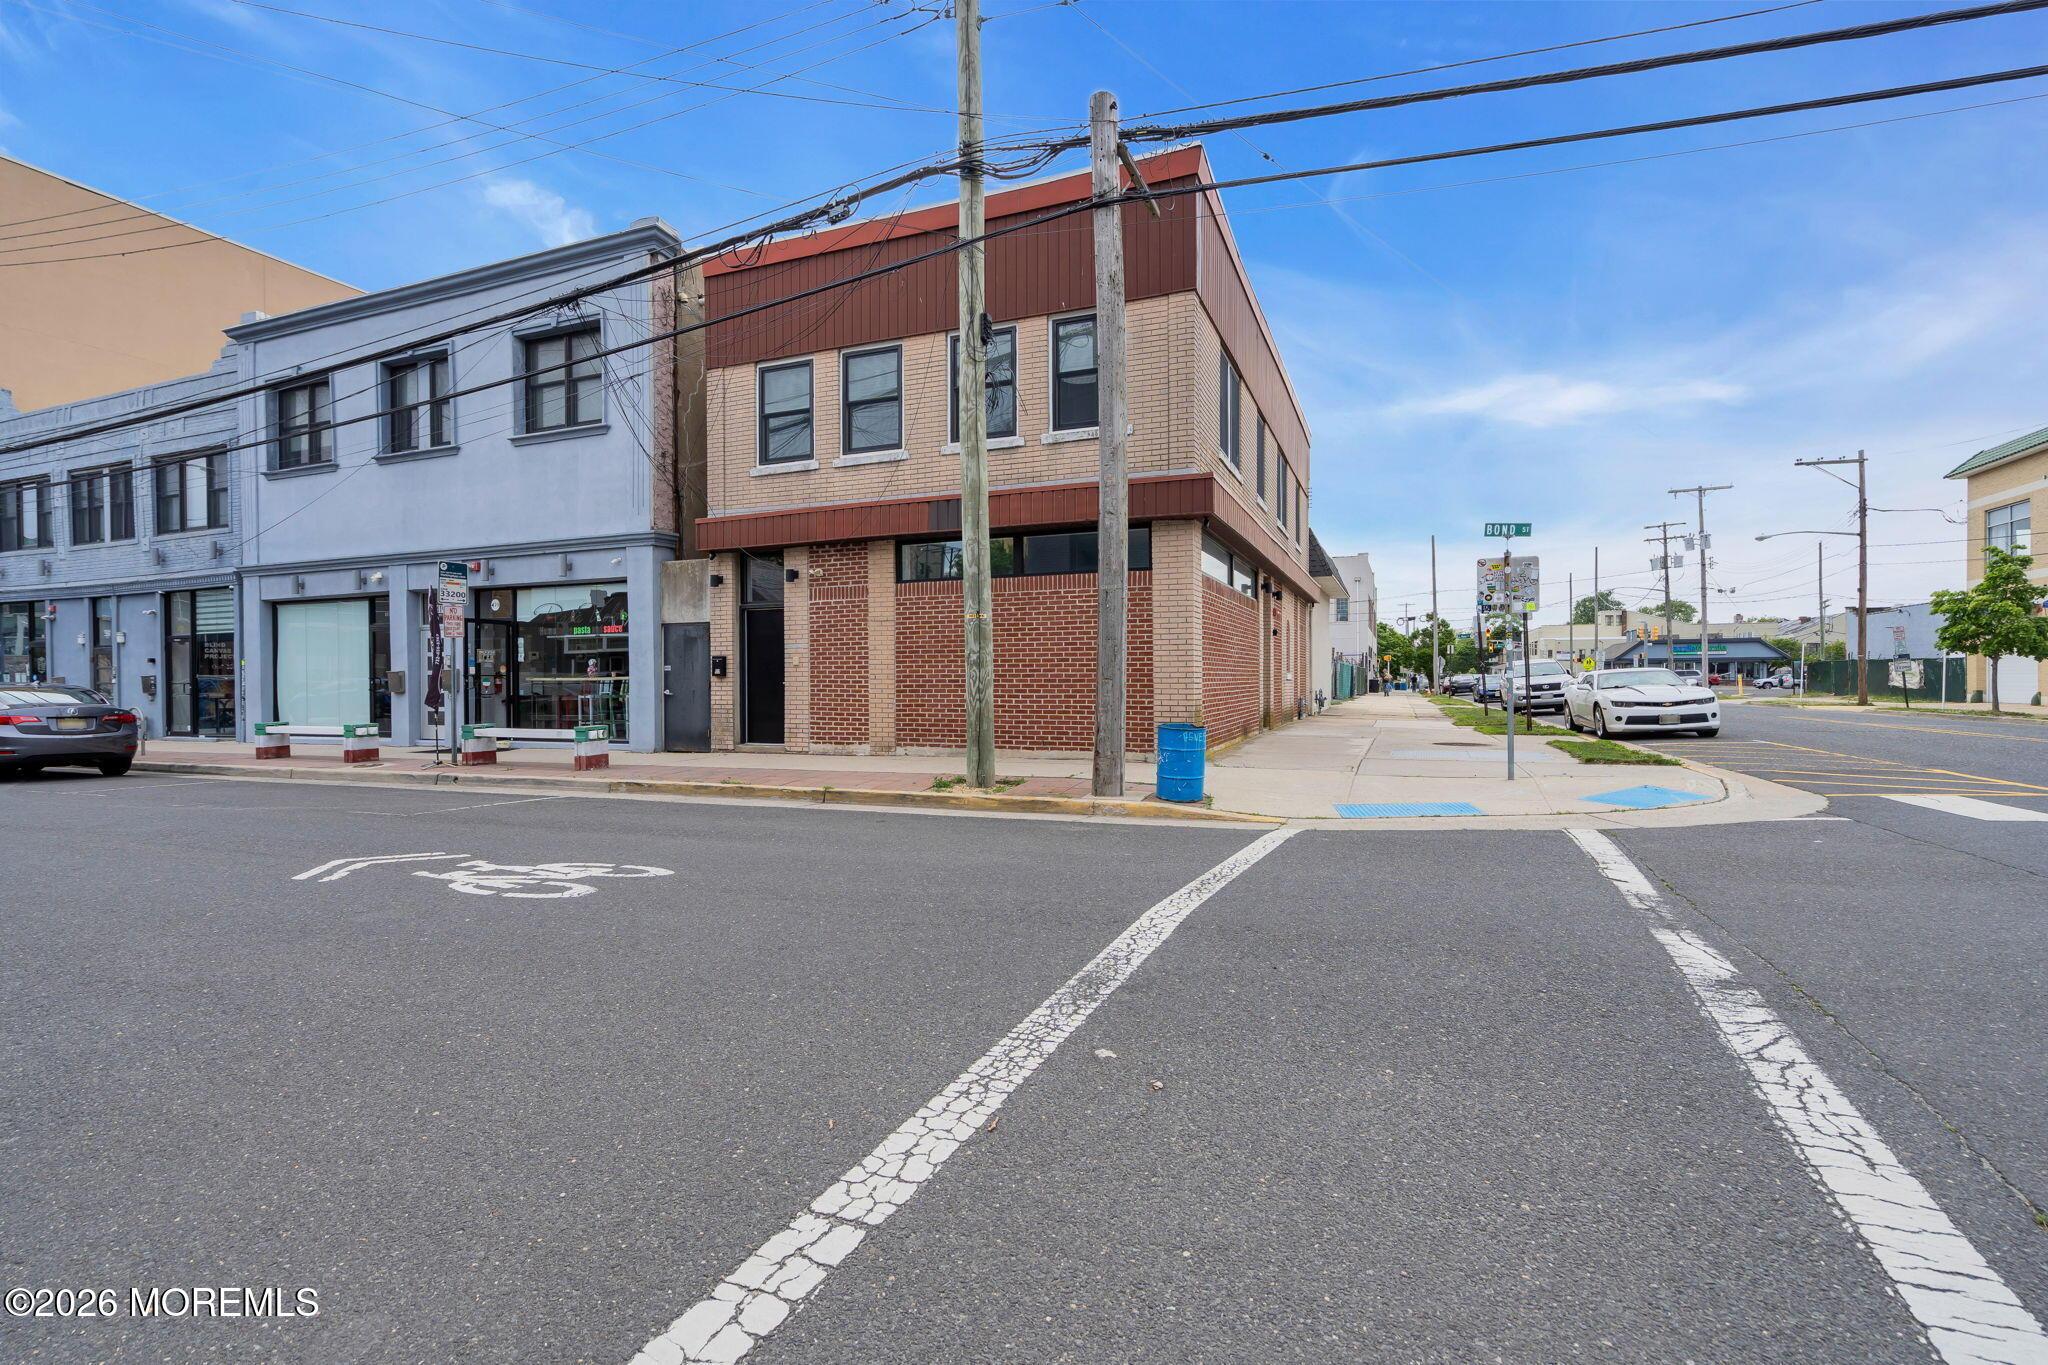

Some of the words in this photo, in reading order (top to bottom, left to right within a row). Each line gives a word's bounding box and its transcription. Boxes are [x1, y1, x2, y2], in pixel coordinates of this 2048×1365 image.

[1486, 524, 1516, 536] BOND
[440, 590, 466, 598] 33200
[449, 607, 458, 615] NO
[573, 625, 591, 635] pasta
[603, 624, 624, 633] sauce
